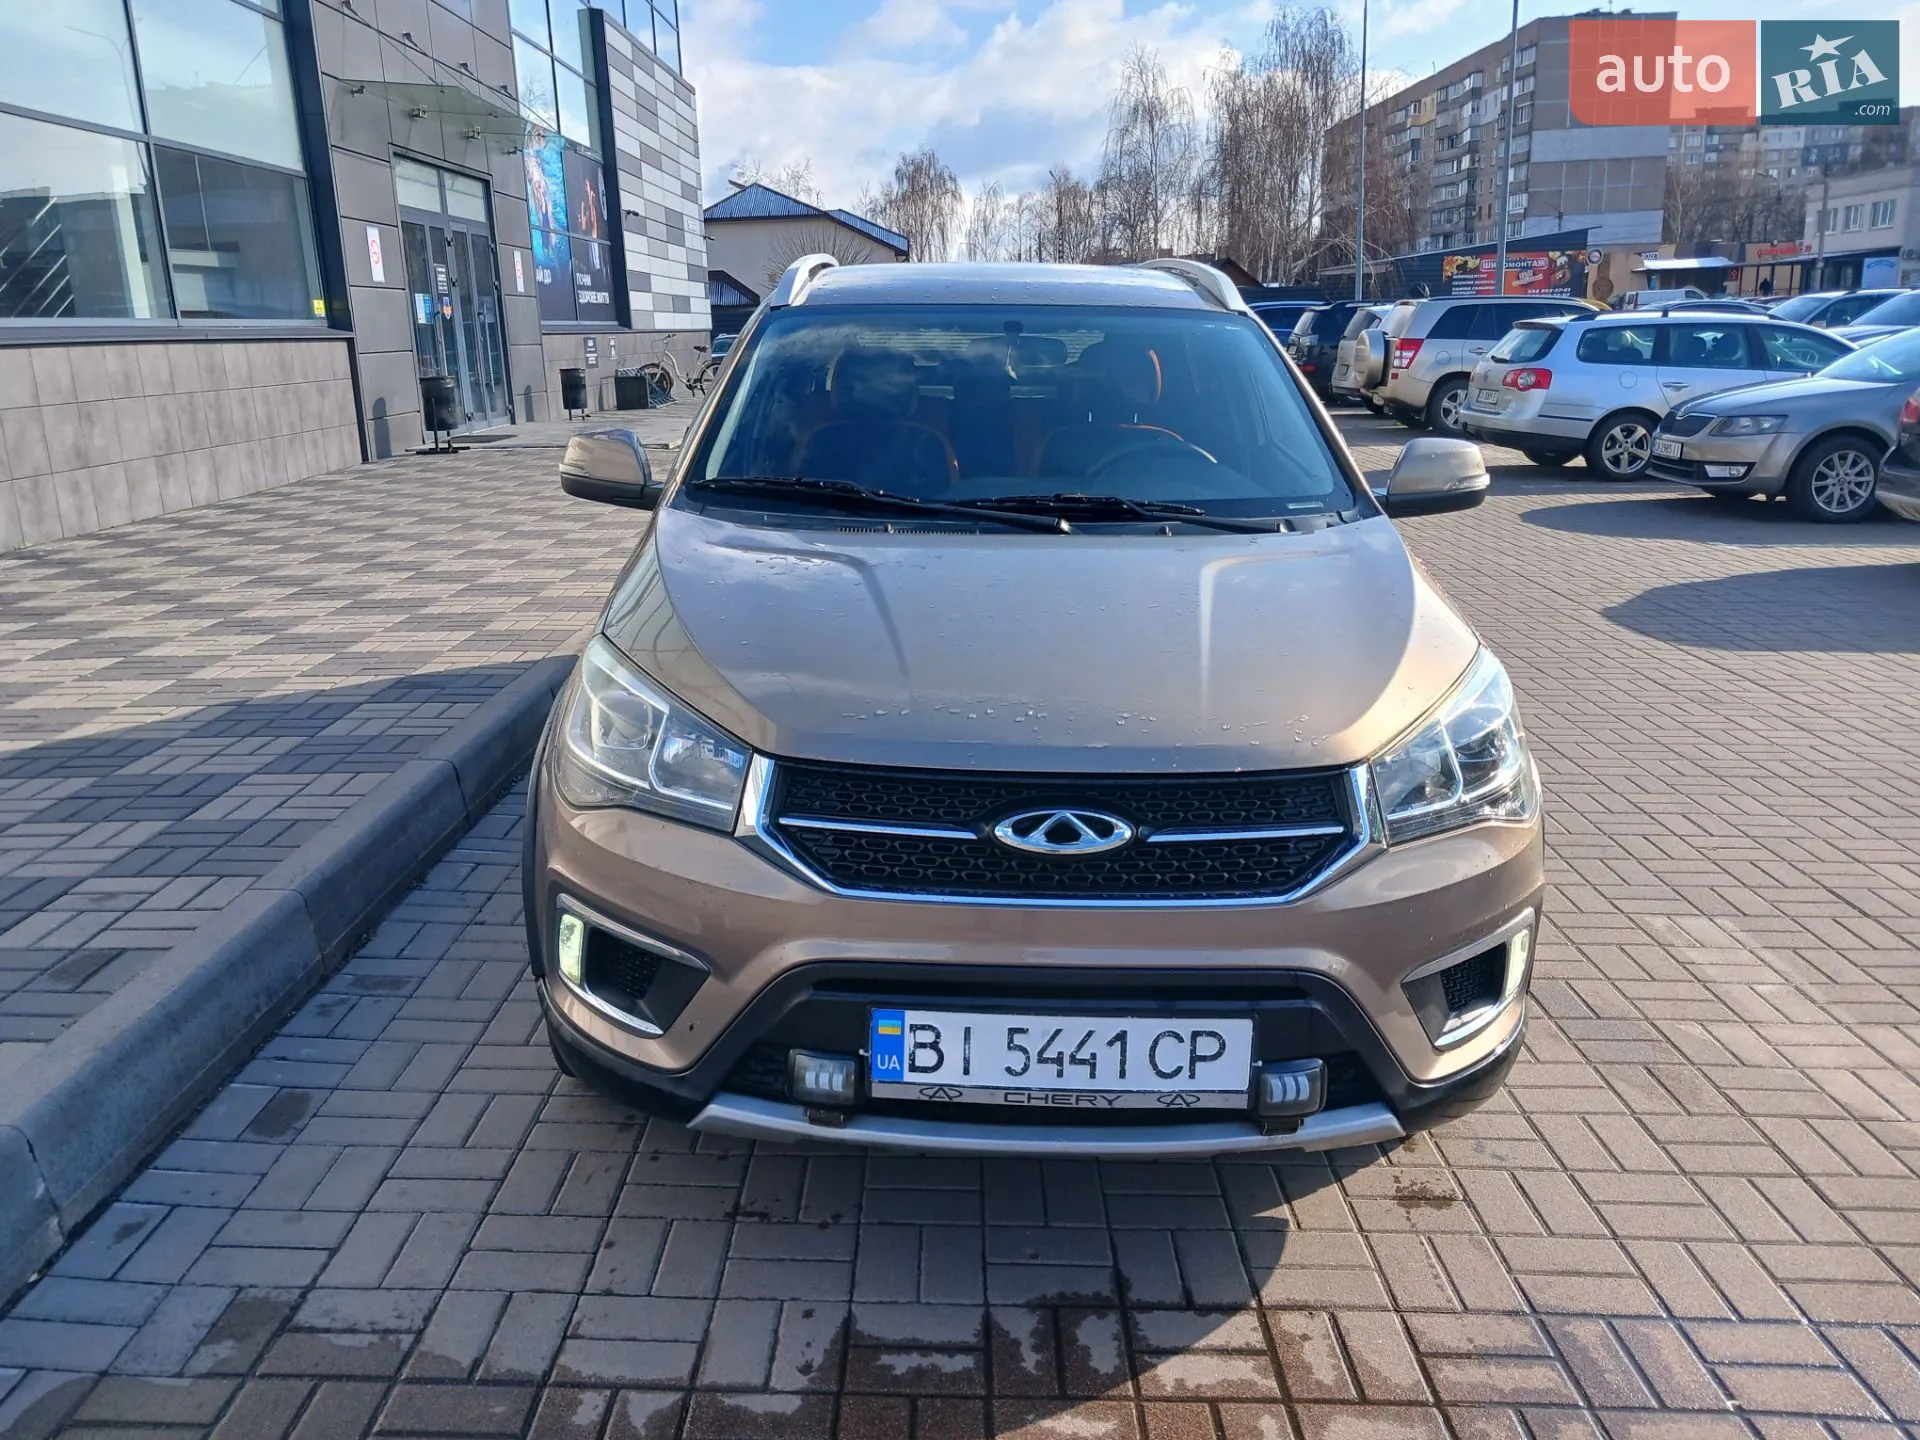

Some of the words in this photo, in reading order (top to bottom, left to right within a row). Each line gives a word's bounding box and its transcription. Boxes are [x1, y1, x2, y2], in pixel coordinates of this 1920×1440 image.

[1004, 1027, 1128, 1079] 5441
[1148, 1030, 1227, 1079] CP
[877, 1054, 900, 1069] UA
[1003, 1092, 1123, 1107] CHERY
